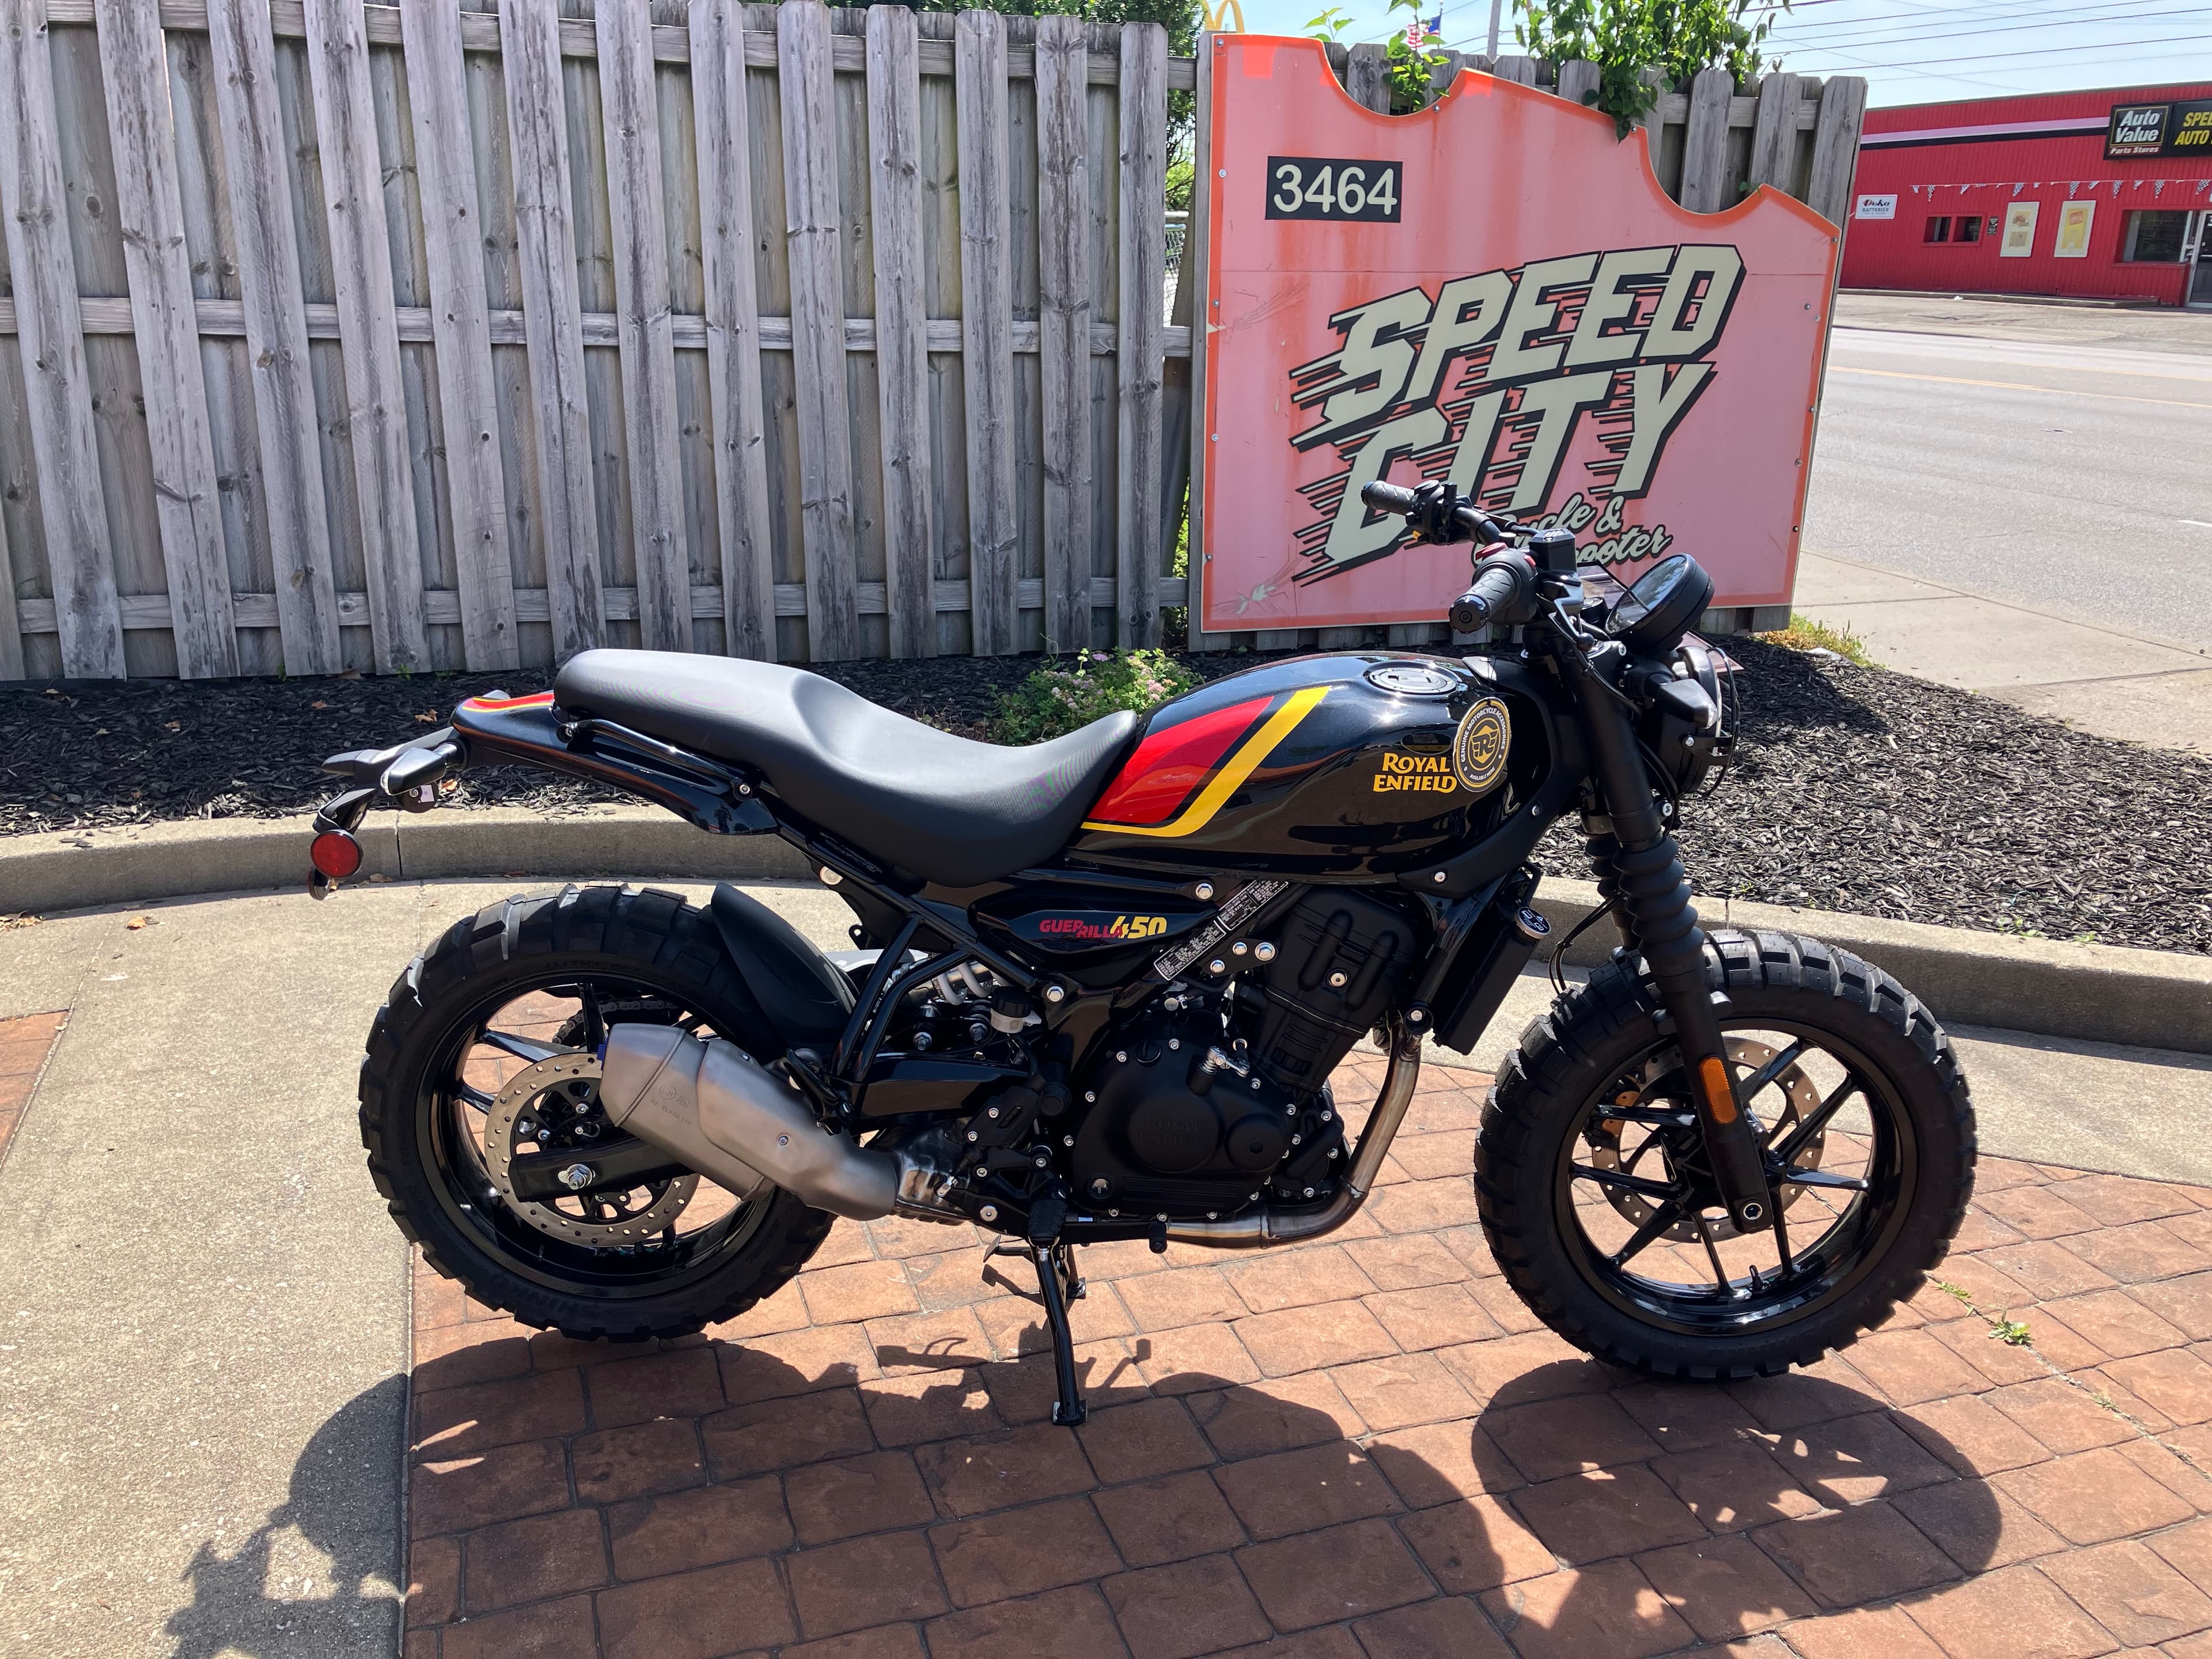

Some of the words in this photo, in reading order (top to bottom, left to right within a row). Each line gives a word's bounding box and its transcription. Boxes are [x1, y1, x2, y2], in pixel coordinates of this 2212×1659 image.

[2120, 110, 2160, 127] Auto
[2116, 127, 2160, 143] Value
[2175, 130, 2210, 145] AUTO
[2111, 146, 2131, 154] Parts
[1274, 164, 1397, 215] 3464
[1290, 244, 1747, 450] SPEED
[1293, 362, 1718, 585] CITY
[1594, 495, 1624, 536] &
[1461, 730, 1469, 762] GENUINE
[1468, 707, 1497, 731] MOTORCYCLE
[1495, 710, 1507, 750] ACCESSORIES
[1382, 752, 1450, 774] ROYAL
[1373, 774, 1457, 793] ENFIELD
[1110, 916, 1167, 939] 450
